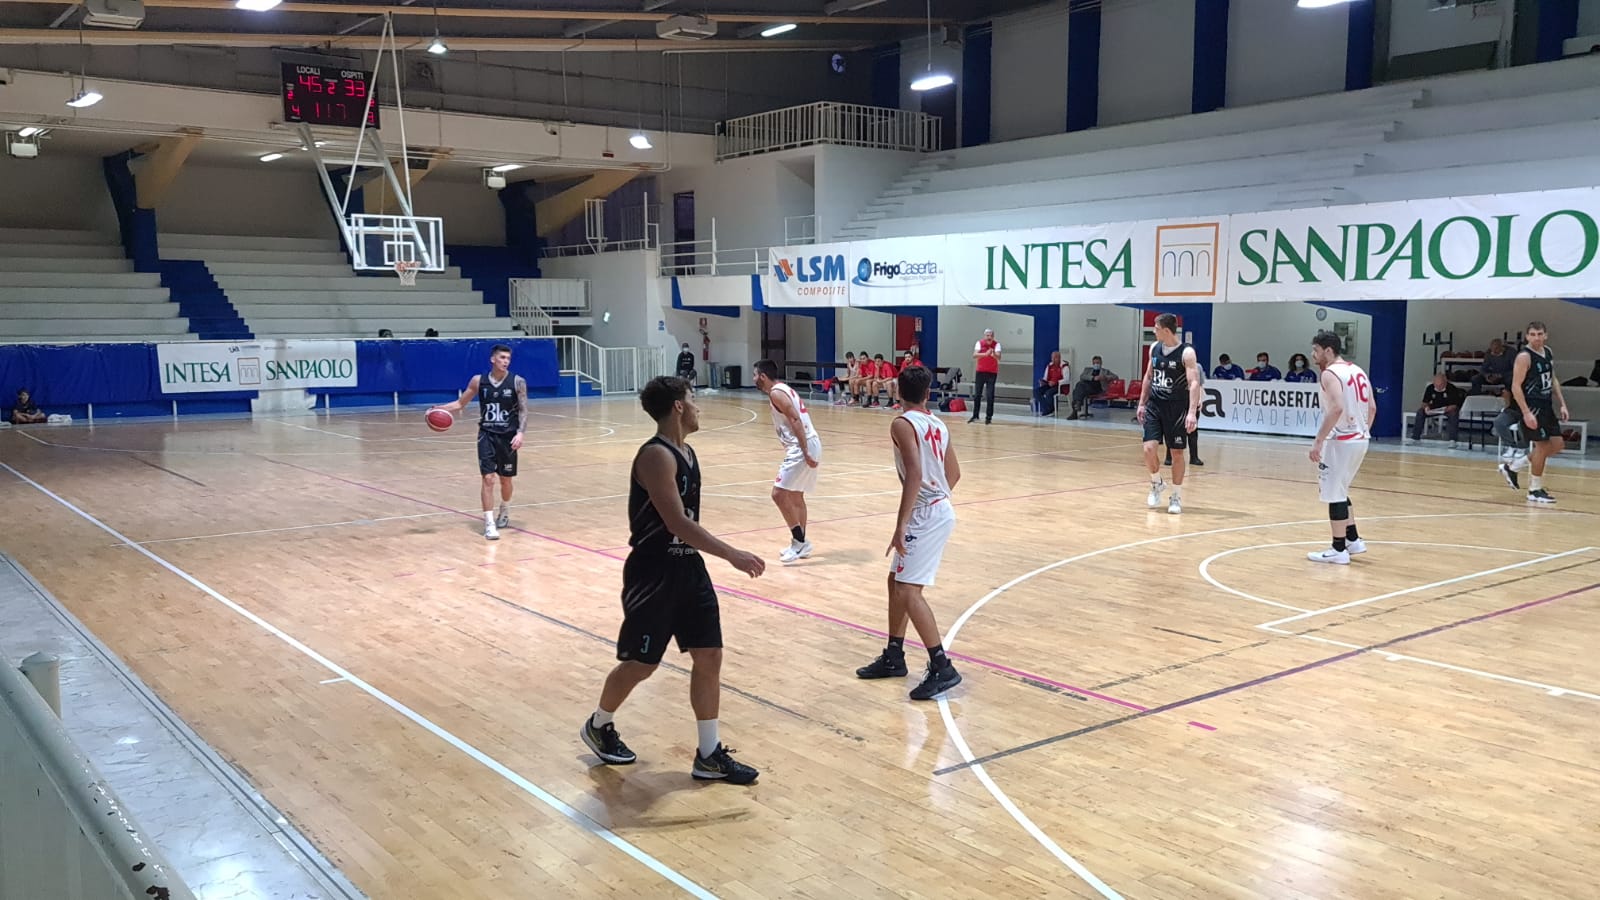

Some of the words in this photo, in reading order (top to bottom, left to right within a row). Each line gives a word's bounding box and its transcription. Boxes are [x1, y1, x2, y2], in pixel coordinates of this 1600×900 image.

[296, 65, 320, 75] LOCALI
[341, 70, 364, 79] OSPITI
[298, 75, 323, 93] 45
[327, 82, 336, 95] 2
[344, 79, 366, 98] 33
[984, 236, 1136, 290] INTESA
[1237, 208, 1600, 287] SANPAOLO
[796, 254, 846, 283] LSM
[797, 286, 846, 297] COMPOSITE
[165, 361, 231, 384] INTESA
[266, 358, 353, 381] SANPAOLO
[1152, 368, 1173, 389] Ble
[1232, 387, 1320, 409] JUVECASERTA
[1346, 372, 1369, 403] 16
[485, 402, 509, 422] Ble
[1232, 407, 1322, 429] ACADEMY
[924, 424, 944, 463] 11
[640, 634, 650, 654] 3
